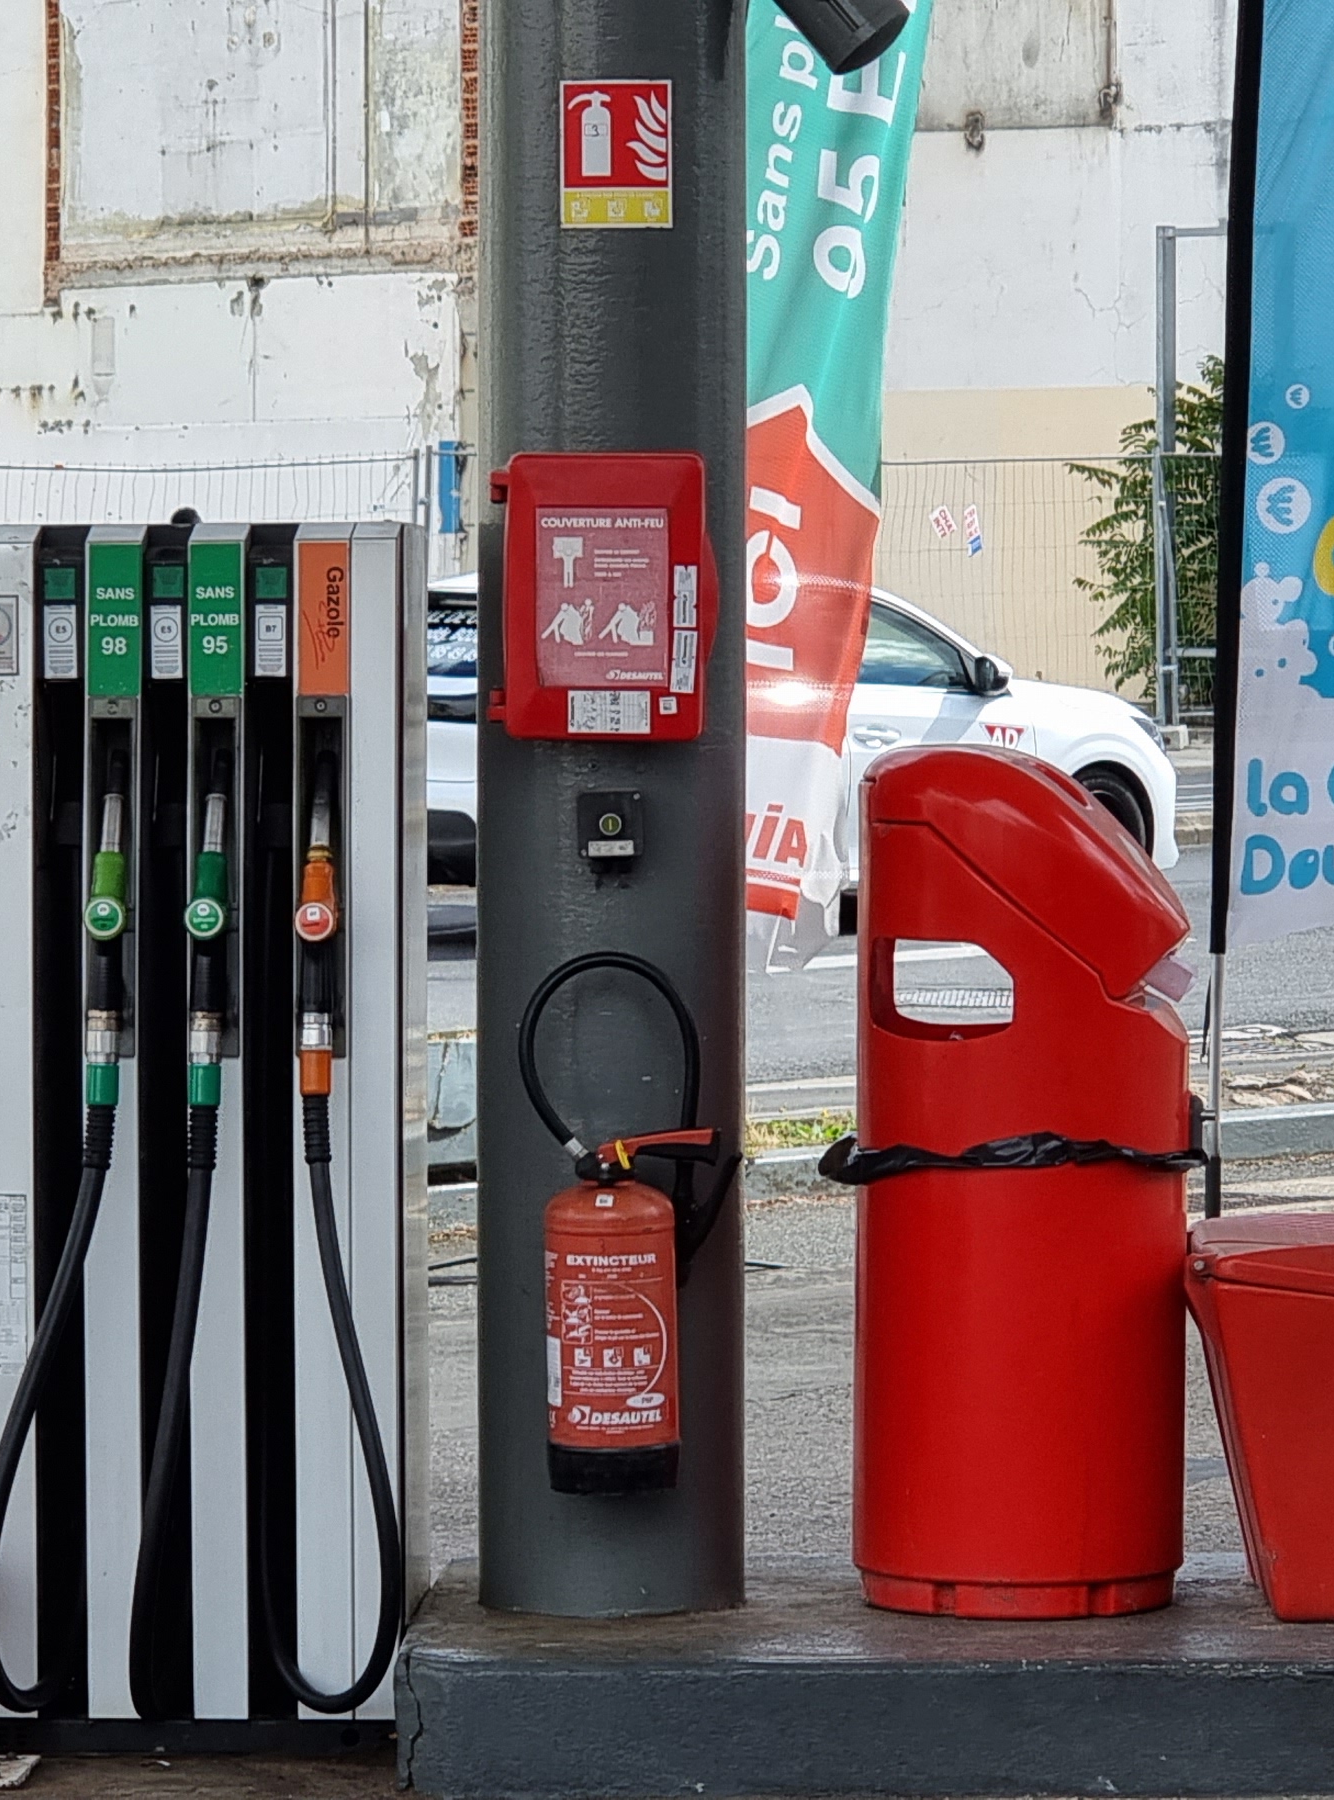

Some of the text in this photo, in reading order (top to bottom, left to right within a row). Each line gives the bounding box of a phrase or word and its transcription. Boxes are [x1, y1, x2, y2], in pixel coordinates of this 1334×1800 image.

[746, 101, 803, 281] Sans
[813, 149, 881, 299] 95
[541, 516, 665, 529] COUVERTURE ANTI-FEU
[746, 486, 802, 672] ICI
[95, 587, 135, 600] SANS
[195, 586, 235, 600] SANS
[326, 566, 345, 639] Gazole
[89, 614, 140, 627] PLOMB
[190, 613, 240, 626] PLOMB
[101, 636, 127, 655] 98
[202, 635, 228, 655] 95
[990, 726, 1019, 750] AD
[1246, 758, 1310, 817] la
[566, 1252, 657, 1267] EXTINCTEUR
[590, 1408, 663, 1426] DESAUTEL
